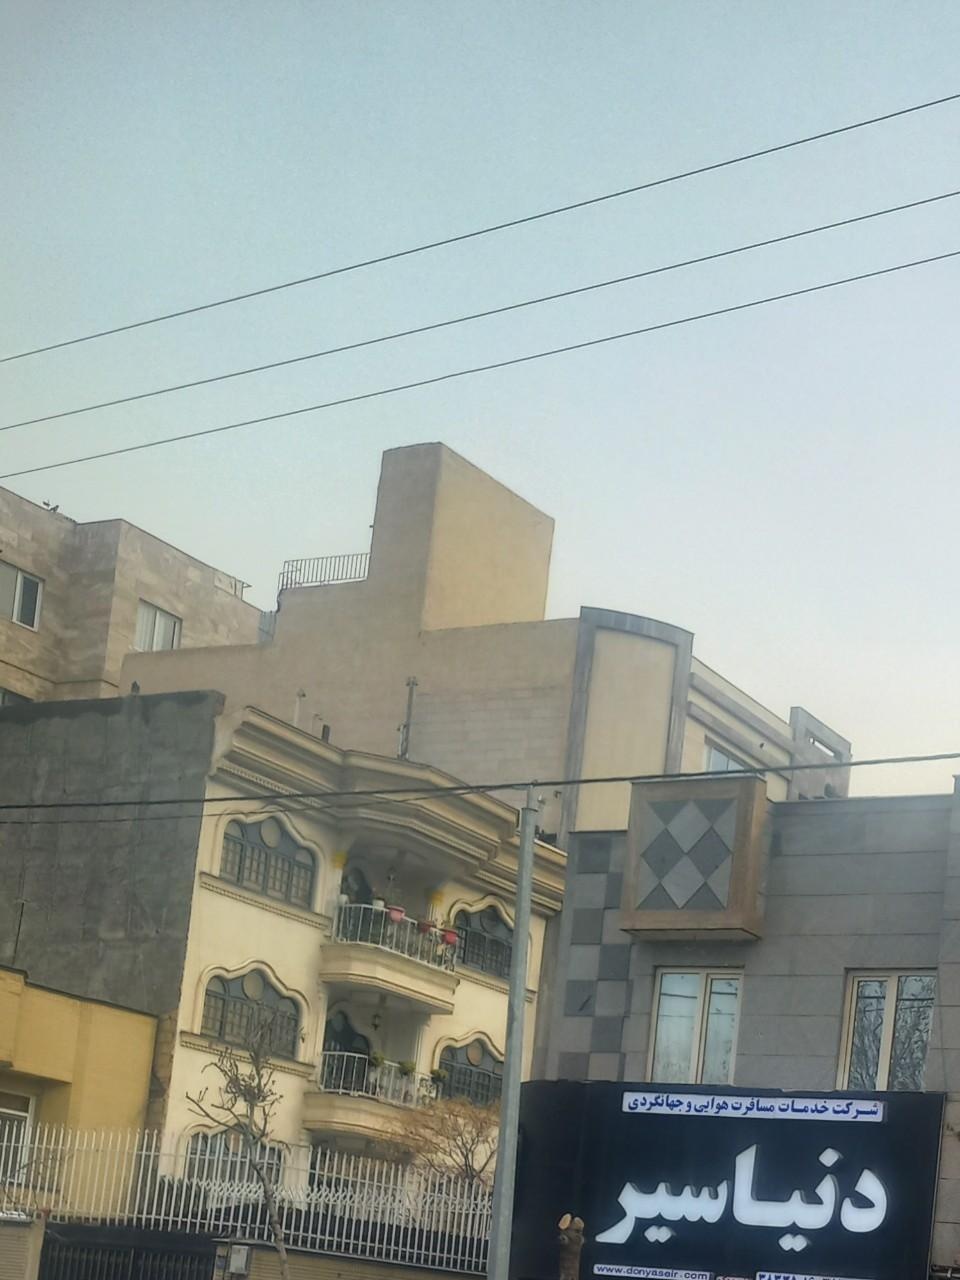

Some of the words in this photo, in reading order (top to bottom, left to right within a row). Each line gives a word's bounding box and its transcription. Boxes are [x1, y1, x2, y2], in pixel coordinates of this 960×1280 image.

[685, 1101, 691, 1112] و
[694, 1096, 728, 1114] هوایی
[731, 1097, 775, 1115] مسافرت
[778, 1099, 829, 1114] خدمات
[832, 1101, 878, 1119] شرکت
